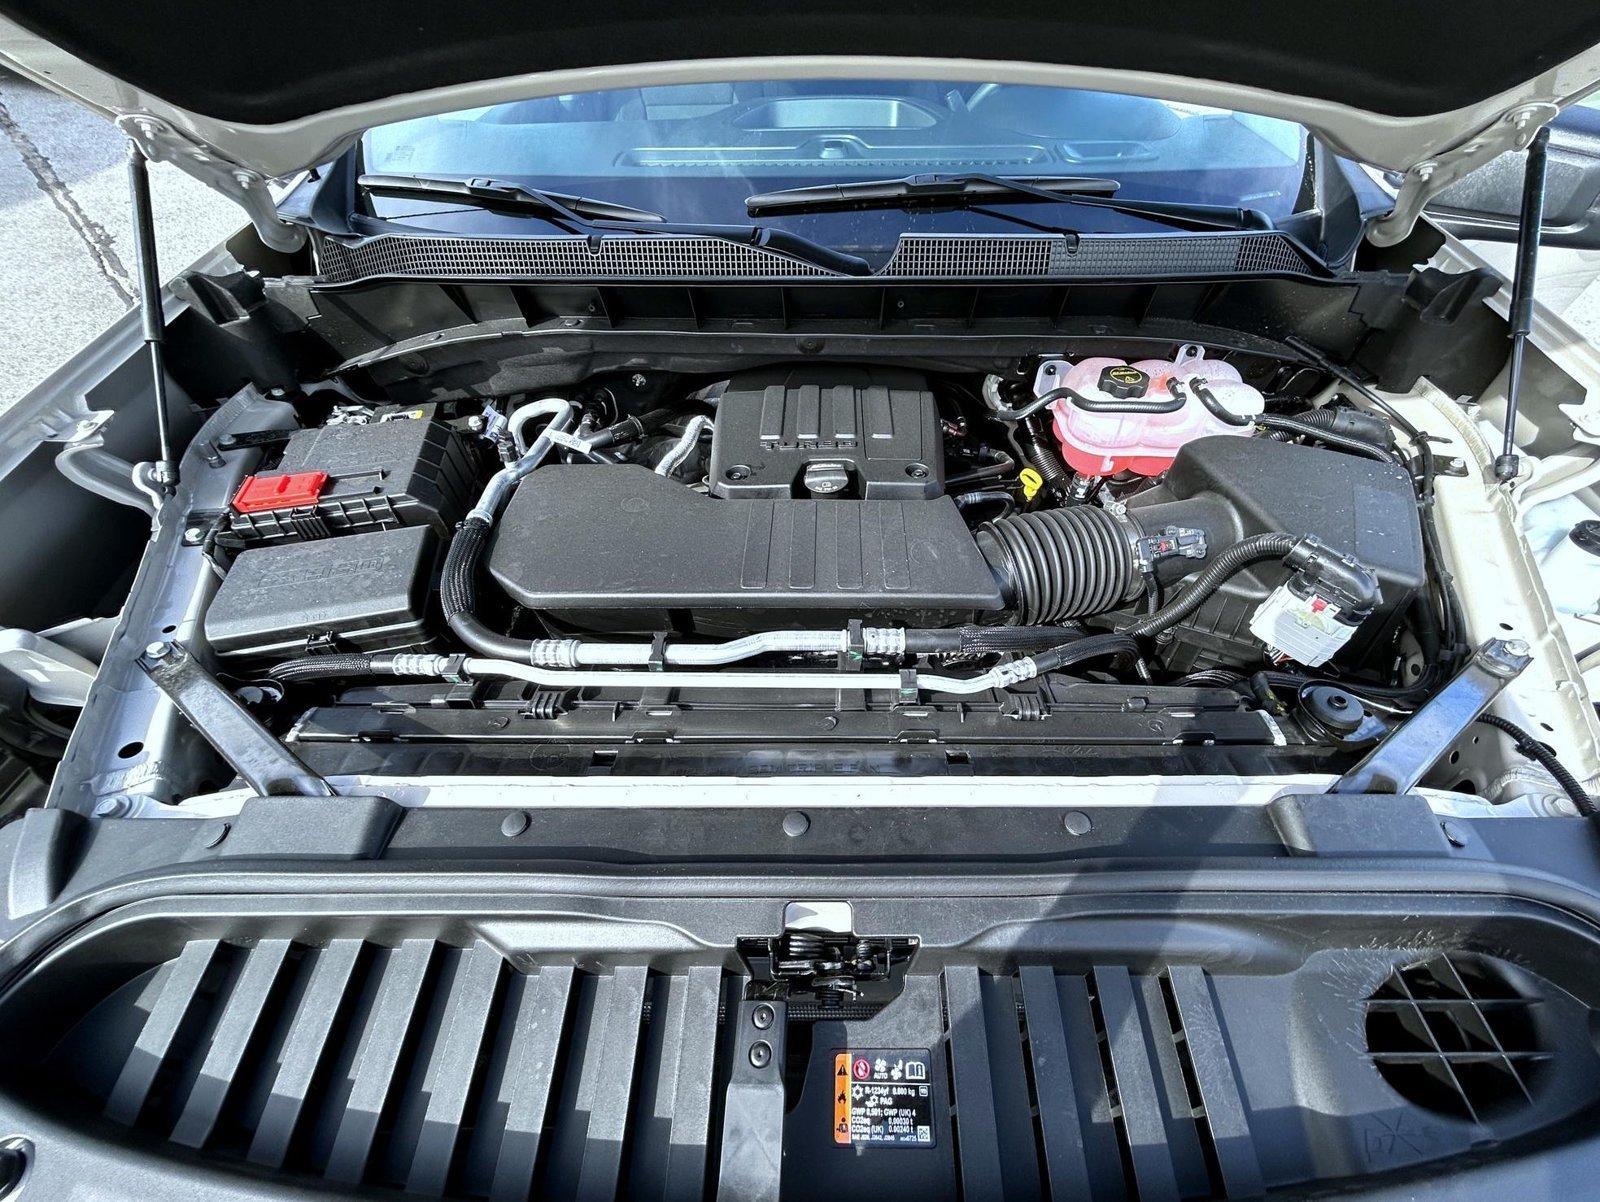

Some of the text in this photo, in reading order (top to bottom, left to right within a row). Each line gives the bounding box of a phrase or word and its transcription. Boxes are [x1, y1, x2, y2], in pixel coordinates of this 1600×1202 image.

[865, 1086, 889, 1097] R-1234yf
[908, 1087, 915, 1097] kg
[880, 1097, 893, 1105] PAG
[852, 1107, 865, 1116] GWP
[883, 1108, 898, 1116] GWP
[898, 1108, 911, 1118] (UK)
[912, 1109, 916, 1117] 4
[871, 1125, 884, 1135] (UK)
